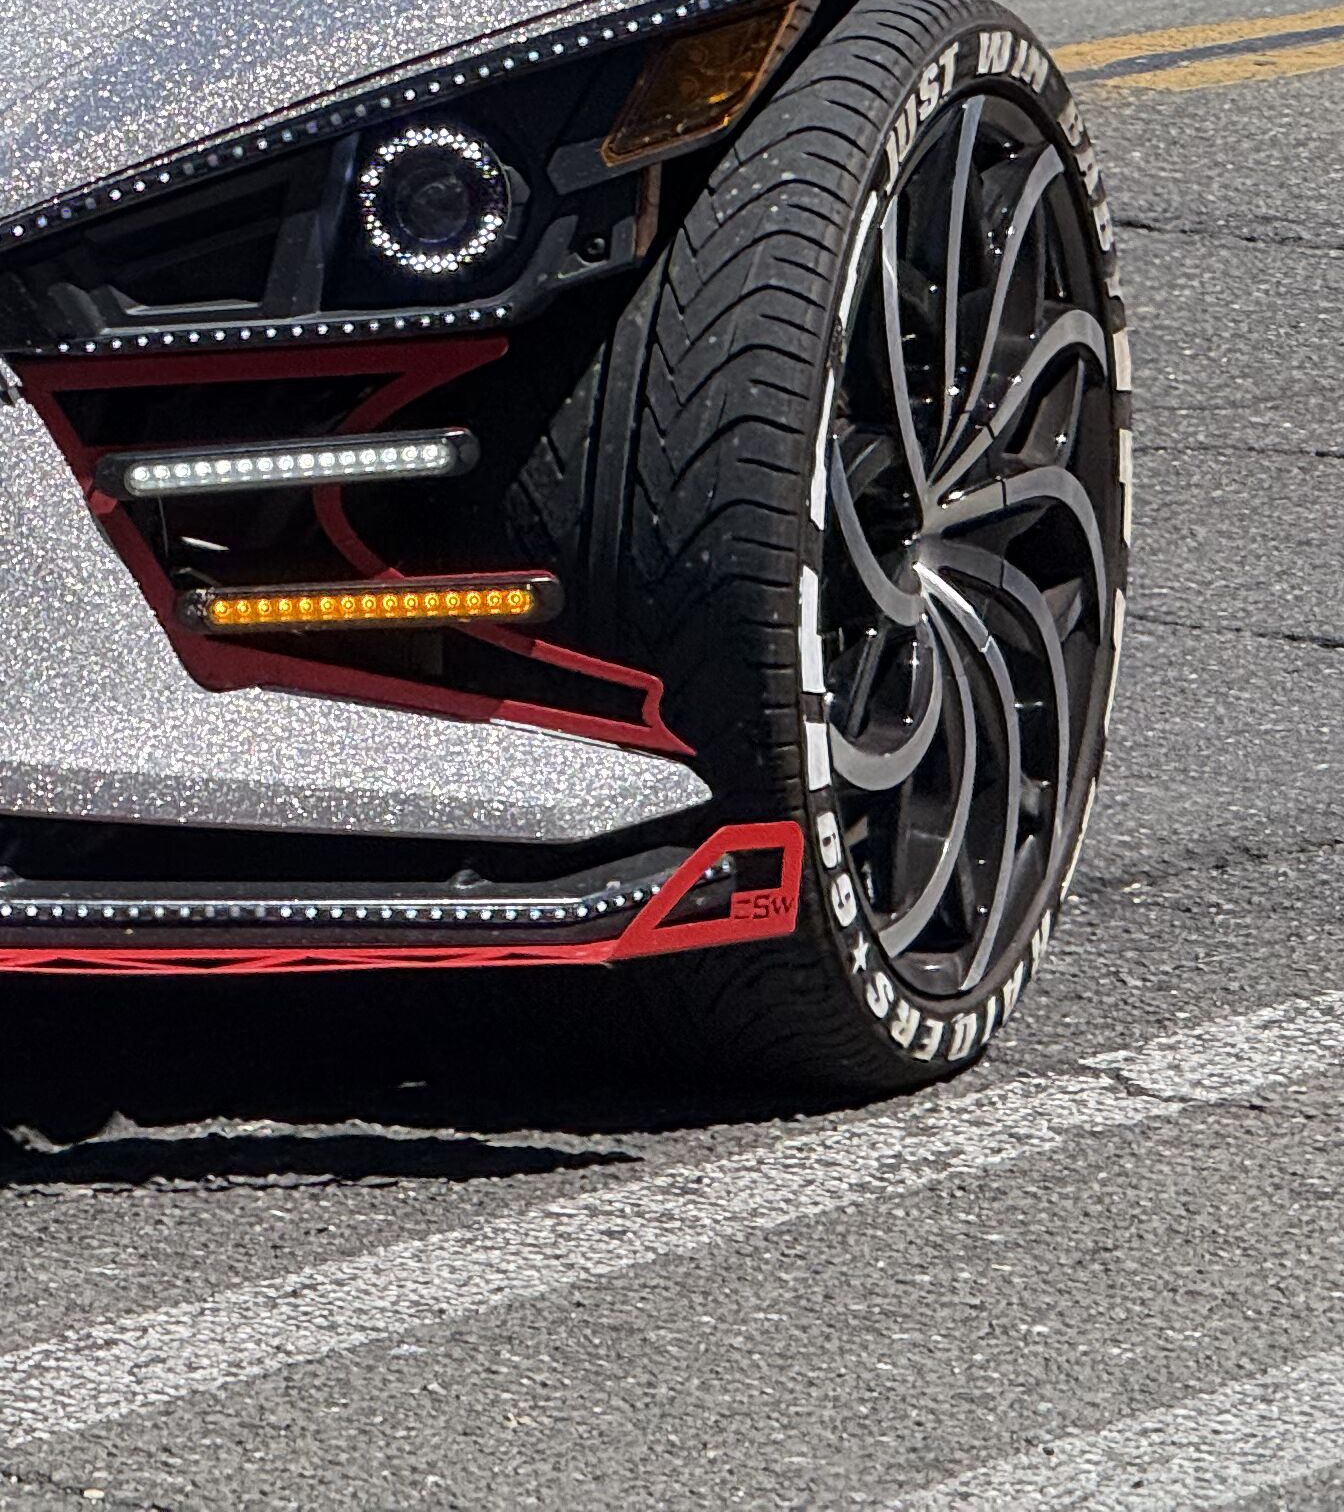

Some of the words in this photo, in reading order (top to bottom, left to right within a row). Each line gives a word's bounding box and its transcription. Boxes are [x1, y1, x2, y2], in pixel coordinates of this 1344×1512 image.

[884, 41, 960, 197] JUST
[976, 31, 1049, 94] WIN
[865, 909, 1051, 1063] RAIDERS
